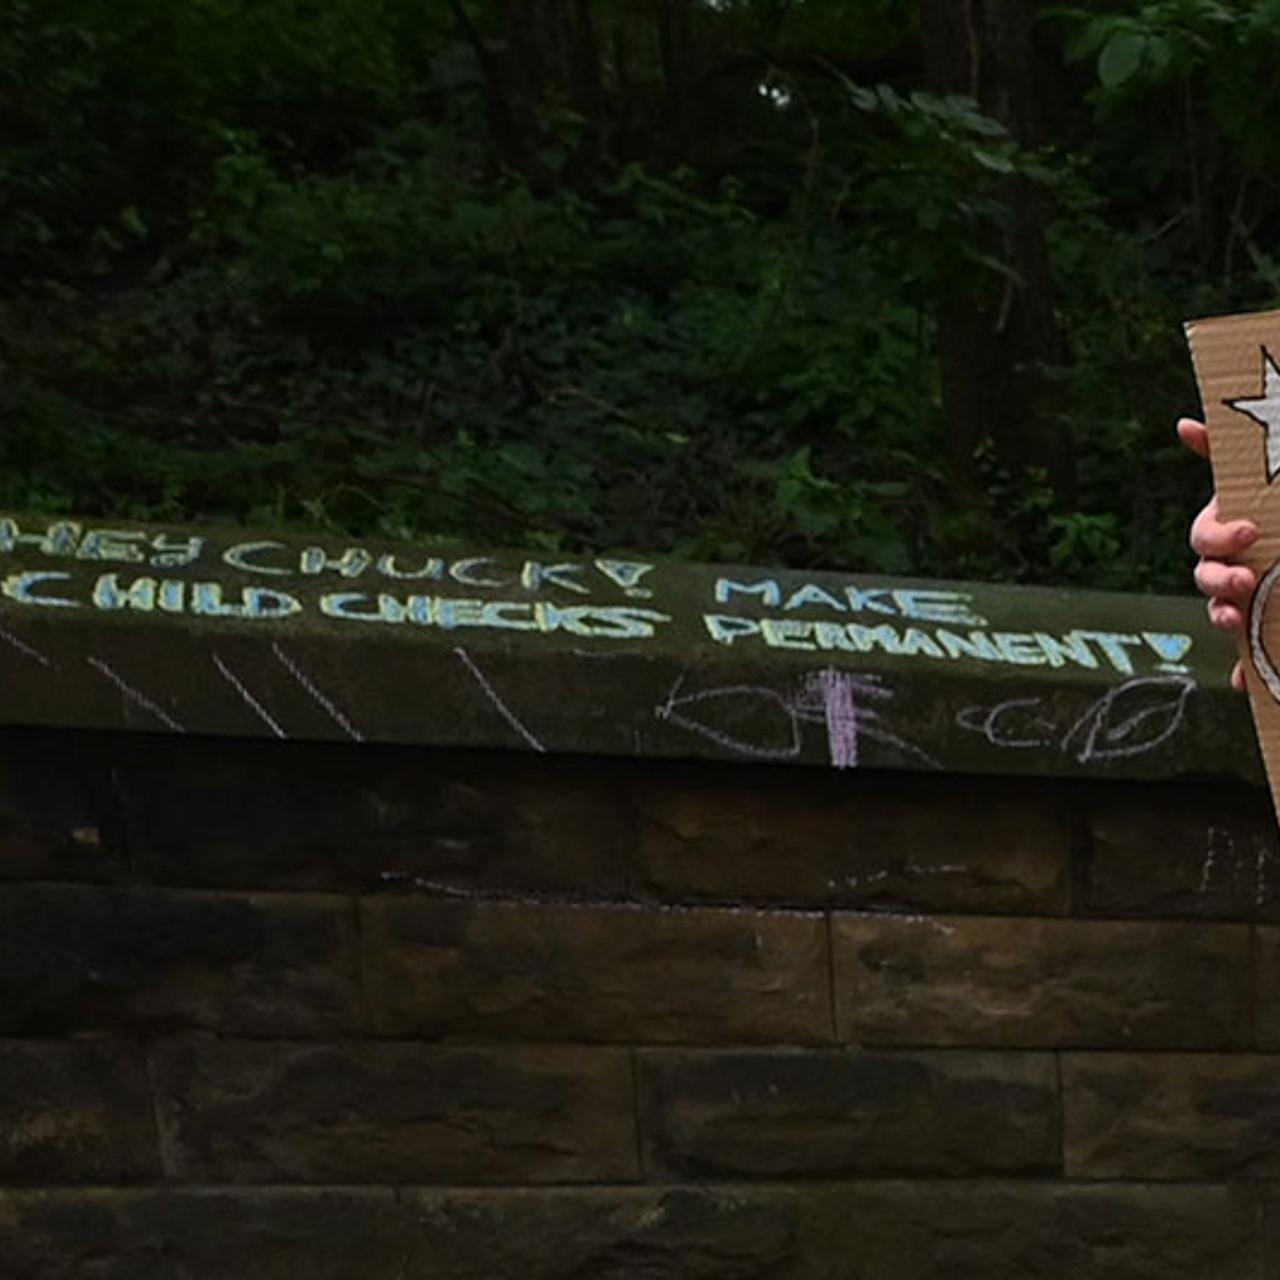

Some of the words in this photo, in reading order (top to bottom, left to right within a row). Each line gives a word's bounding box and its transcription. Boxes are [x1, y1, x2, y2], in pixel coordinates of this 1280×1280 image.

[0, 517, 206, 568] HEY
[714, 577, 987, 627] MAKE
[1, 570, 304, 618] CHILD
[319, 592, 672, 639] CHECKS
[702, 613, 1194, 676] PERMANENT!
